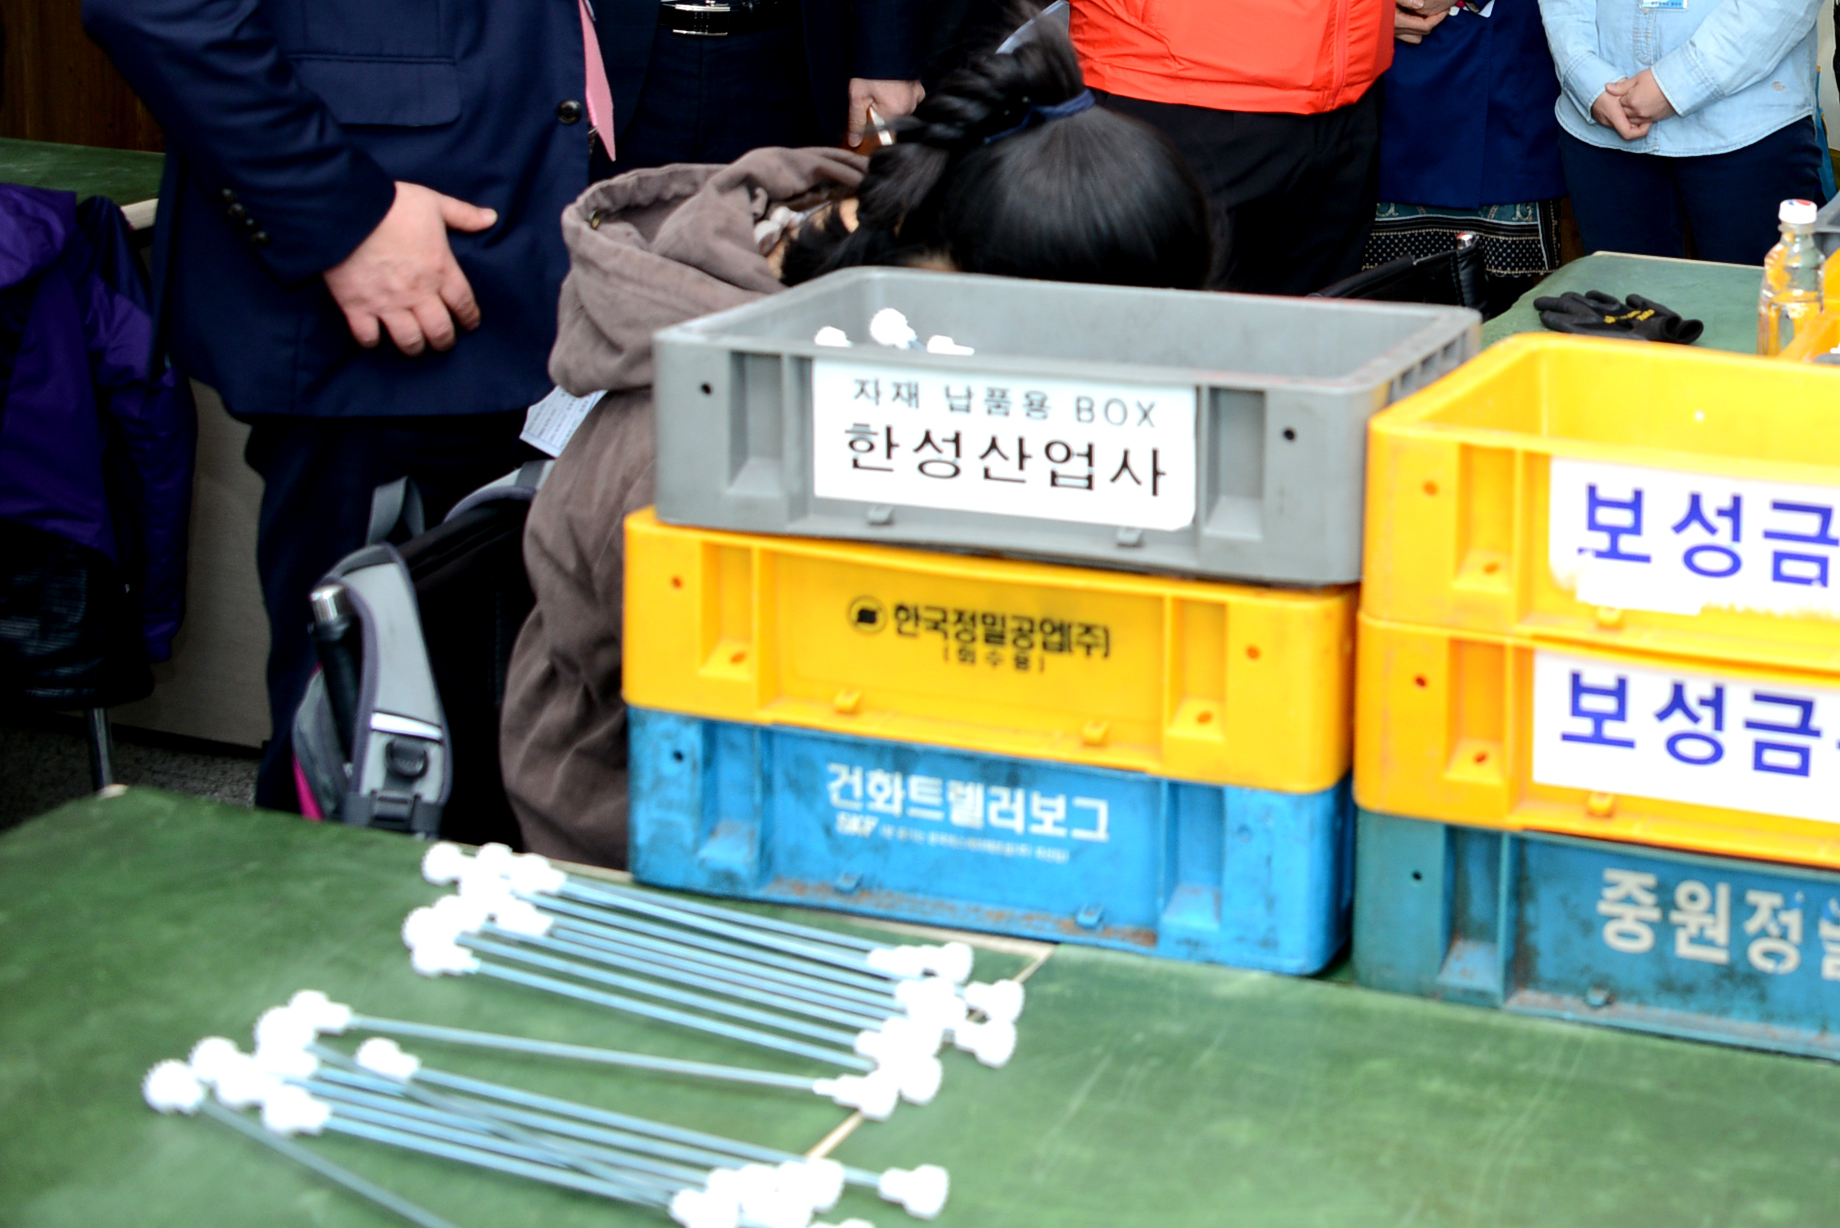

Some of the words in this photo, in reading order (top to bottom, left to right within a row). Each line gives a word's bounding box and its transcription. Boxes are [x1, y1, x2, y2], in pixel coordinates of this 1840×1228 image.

[853, 376, 920, 409] 자재
[944, 384, 1051, 421] 납품용
[1075, 395, 1156, 428] BOX
[844, 422, 1167, 497] 한성산업사
[827, 762, 1110, 843] 건화트렐러보그
